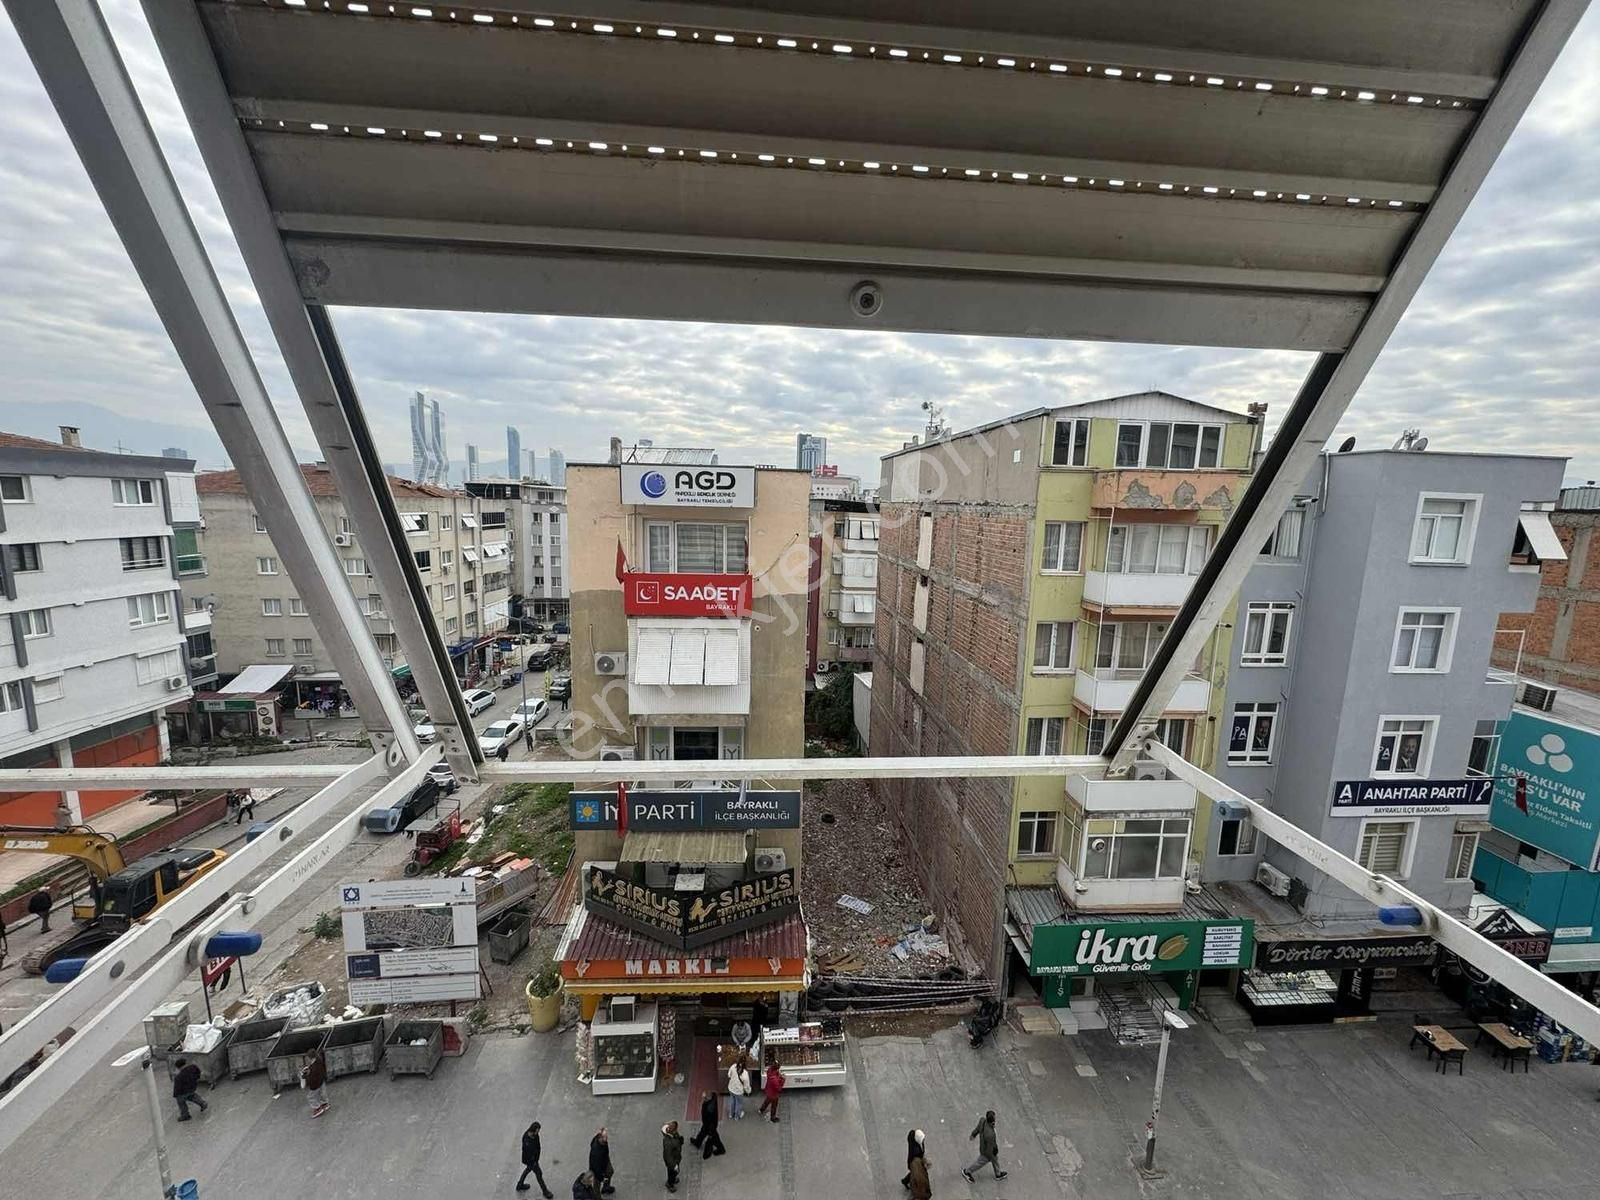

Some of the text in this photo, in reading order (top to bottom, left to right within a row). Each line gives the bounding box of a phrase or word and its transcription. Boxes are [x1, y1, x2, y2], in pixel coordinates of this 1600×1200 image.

[674, 471, 736, 490] AGD
[664, 586, 741, 601] SAADET
[1363, 787, 1428, 800] ANAHTAR
[1430, 784, 1468, 799] PARTİ
[634, 801, 695, 820] PARTİ
[726, 800, 778, 810] BAYRAKLI
[1374, 806, 1403, 814] BAYRAKLI
[1552, 794, 1582, 812] VAR
[714, 810, 790, 822] İLÇE BAŞKANLIĞI
[1076, 928, 1158, 964] ikra
[1270, 940, 1438, 963] Dörtler Kuyumculuk
[1502, 939, 1546, 957] ÖNER
[625, 959, 730, 974] MARKI
[1092, 962, 1151, 974] Güvenilir Gıda
